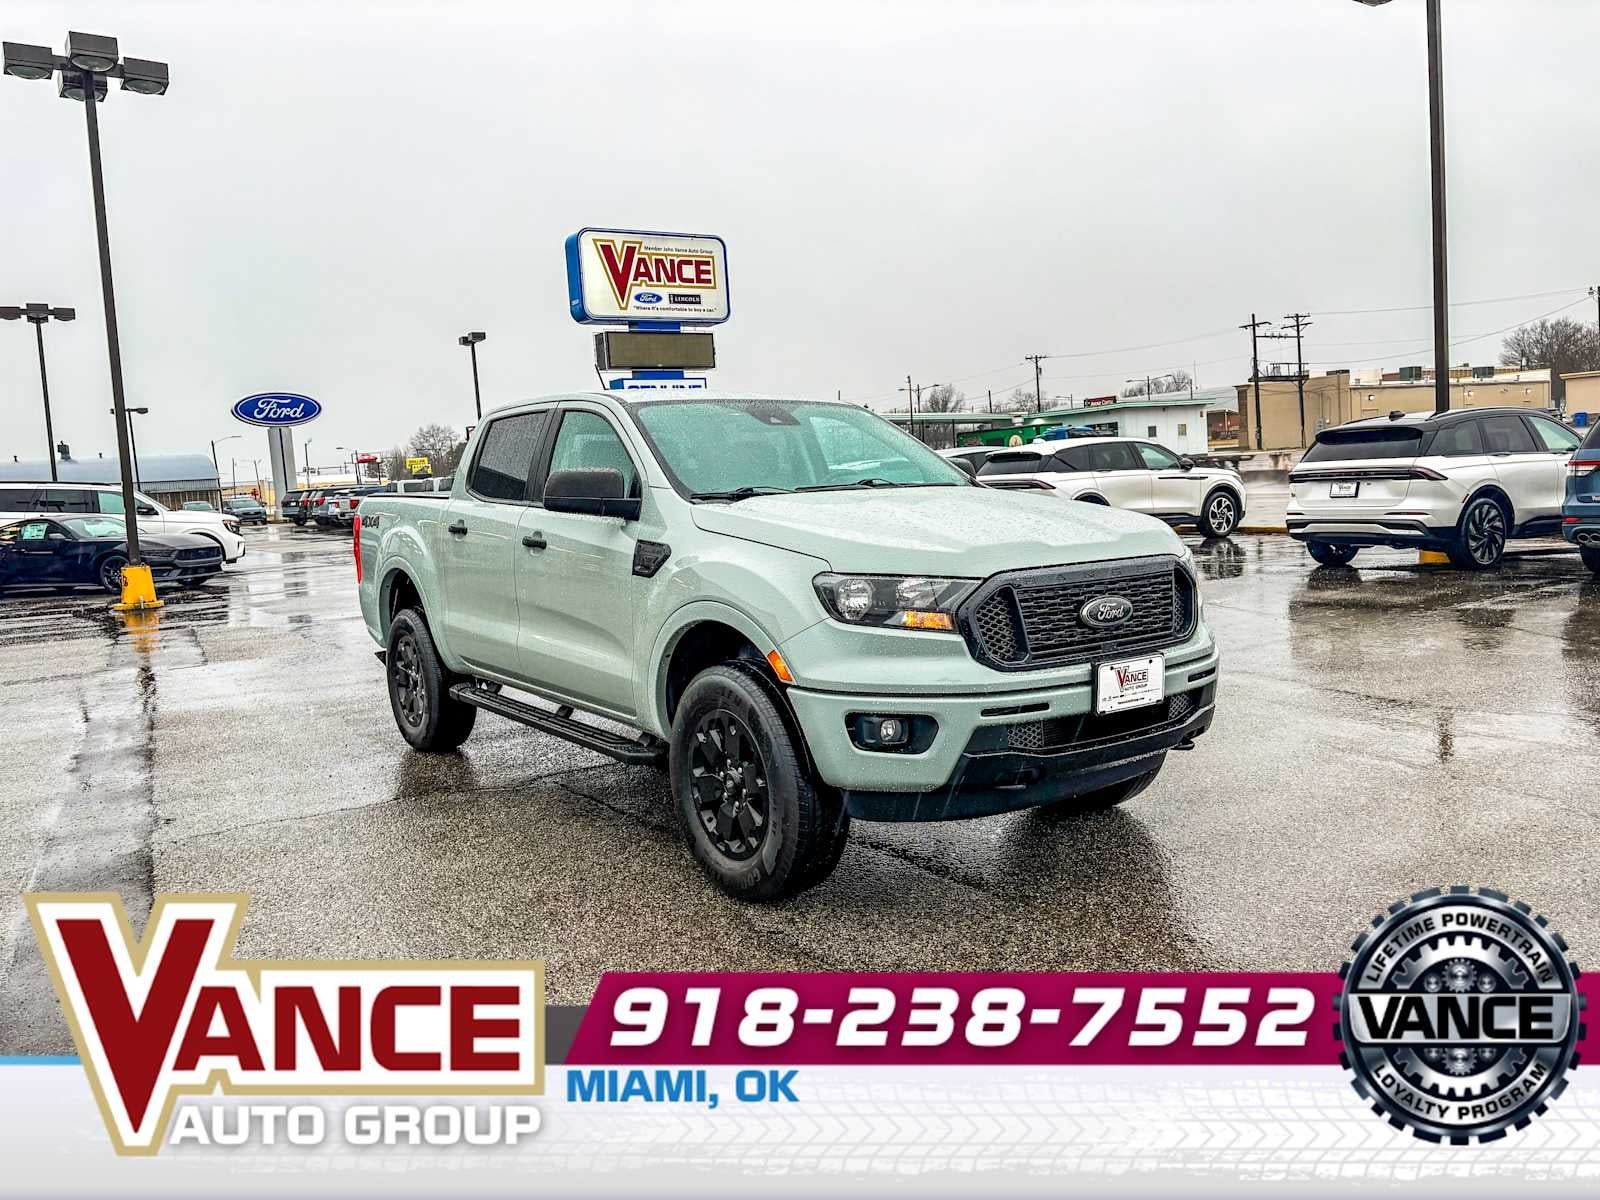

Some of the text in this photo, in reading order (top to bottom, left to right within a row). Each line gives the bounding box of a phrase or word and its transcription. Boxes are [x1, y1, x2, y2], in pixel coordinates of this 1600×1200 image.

[640, 293, 658, 302] Ford
[674, 295, 701, 303] LINCOLN
[253, 398, 305, 419] Ford
[1097, 602, 1125, 621] Ford
